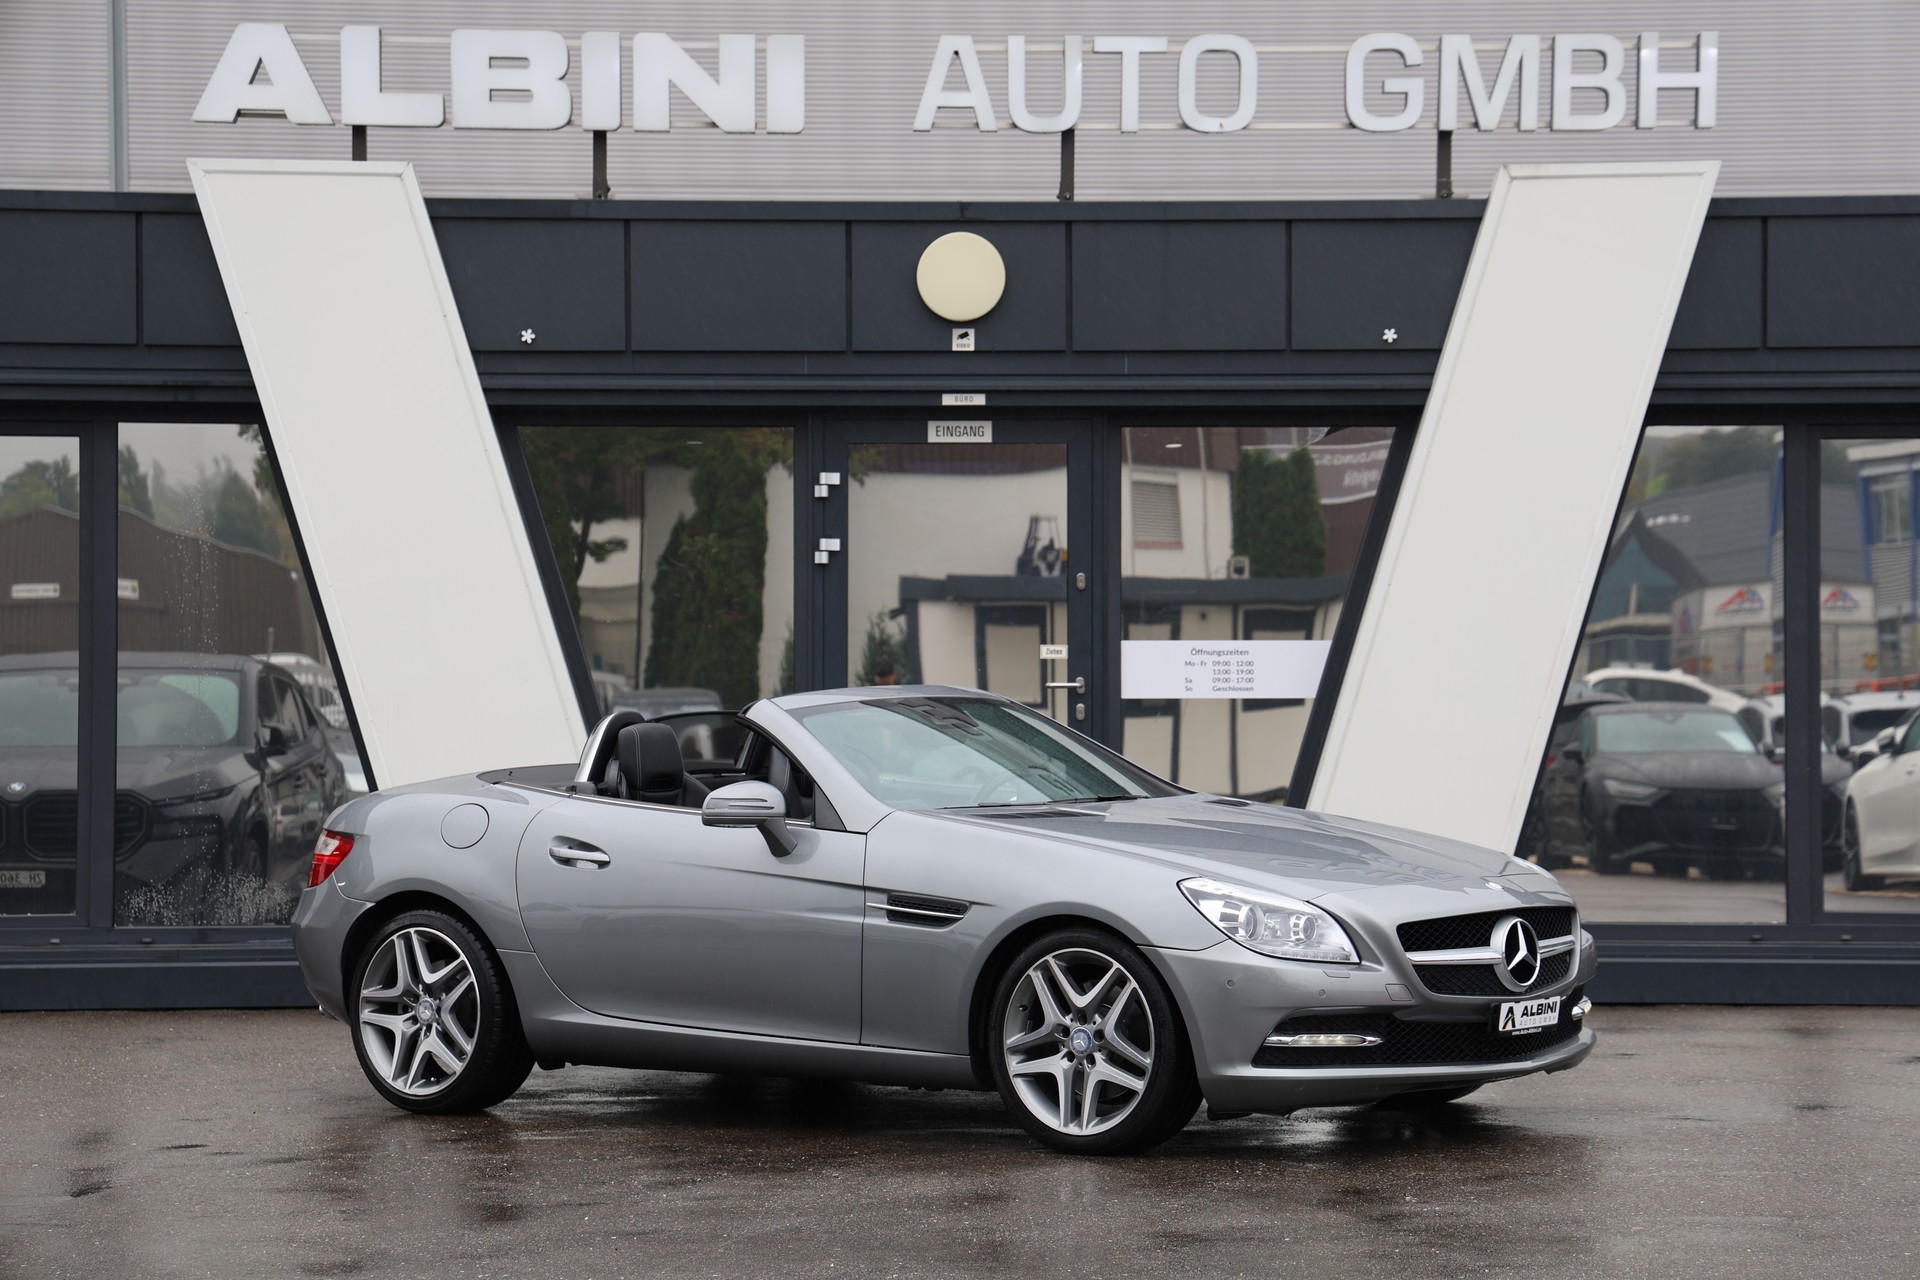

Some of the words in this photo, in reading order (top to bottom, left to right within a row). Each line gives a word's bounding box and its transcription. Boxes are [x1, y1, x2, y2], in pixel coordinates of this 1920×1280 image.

[191, 22, 806, 134] ALBINI
[913, 33, 1259, 134] AUTO
[1344, 31, 1719, 132] GMBH
[935, 425, 985, 438] EINGANG
[1045, 647, 1063, 655] Ziehen
[1190, 648, 1249, 657] Öffnungszeiten
[1520, 1001, 1558, 1018] ALBINI
